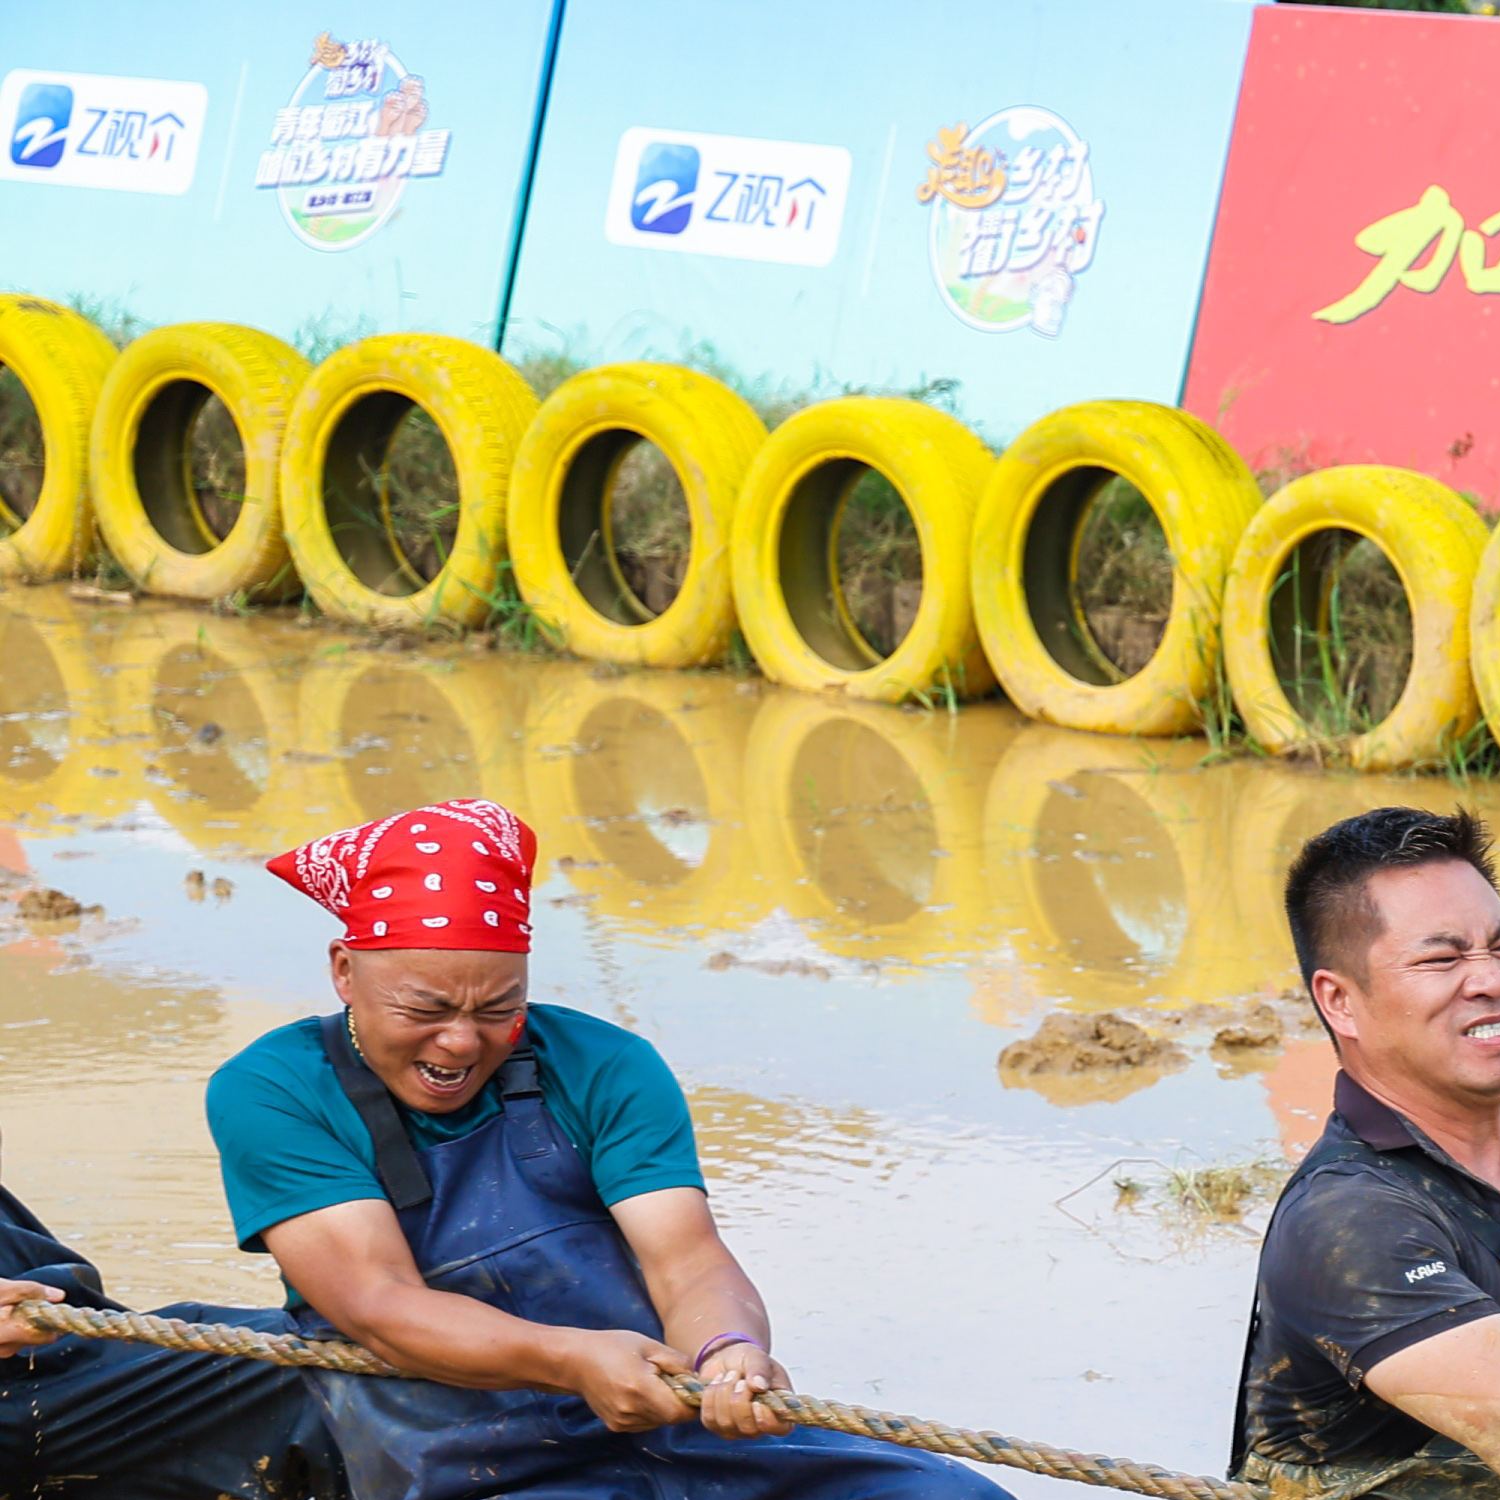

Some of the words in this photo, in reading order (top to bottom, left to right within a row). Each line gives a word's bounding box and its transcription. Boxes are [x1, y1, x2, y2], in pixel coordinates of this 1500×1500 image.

[75, 107, 186, 162] Z视介
[703, 170, 827, 231] Z视介
[1404, 1260, 1447, 1284] KAWS
